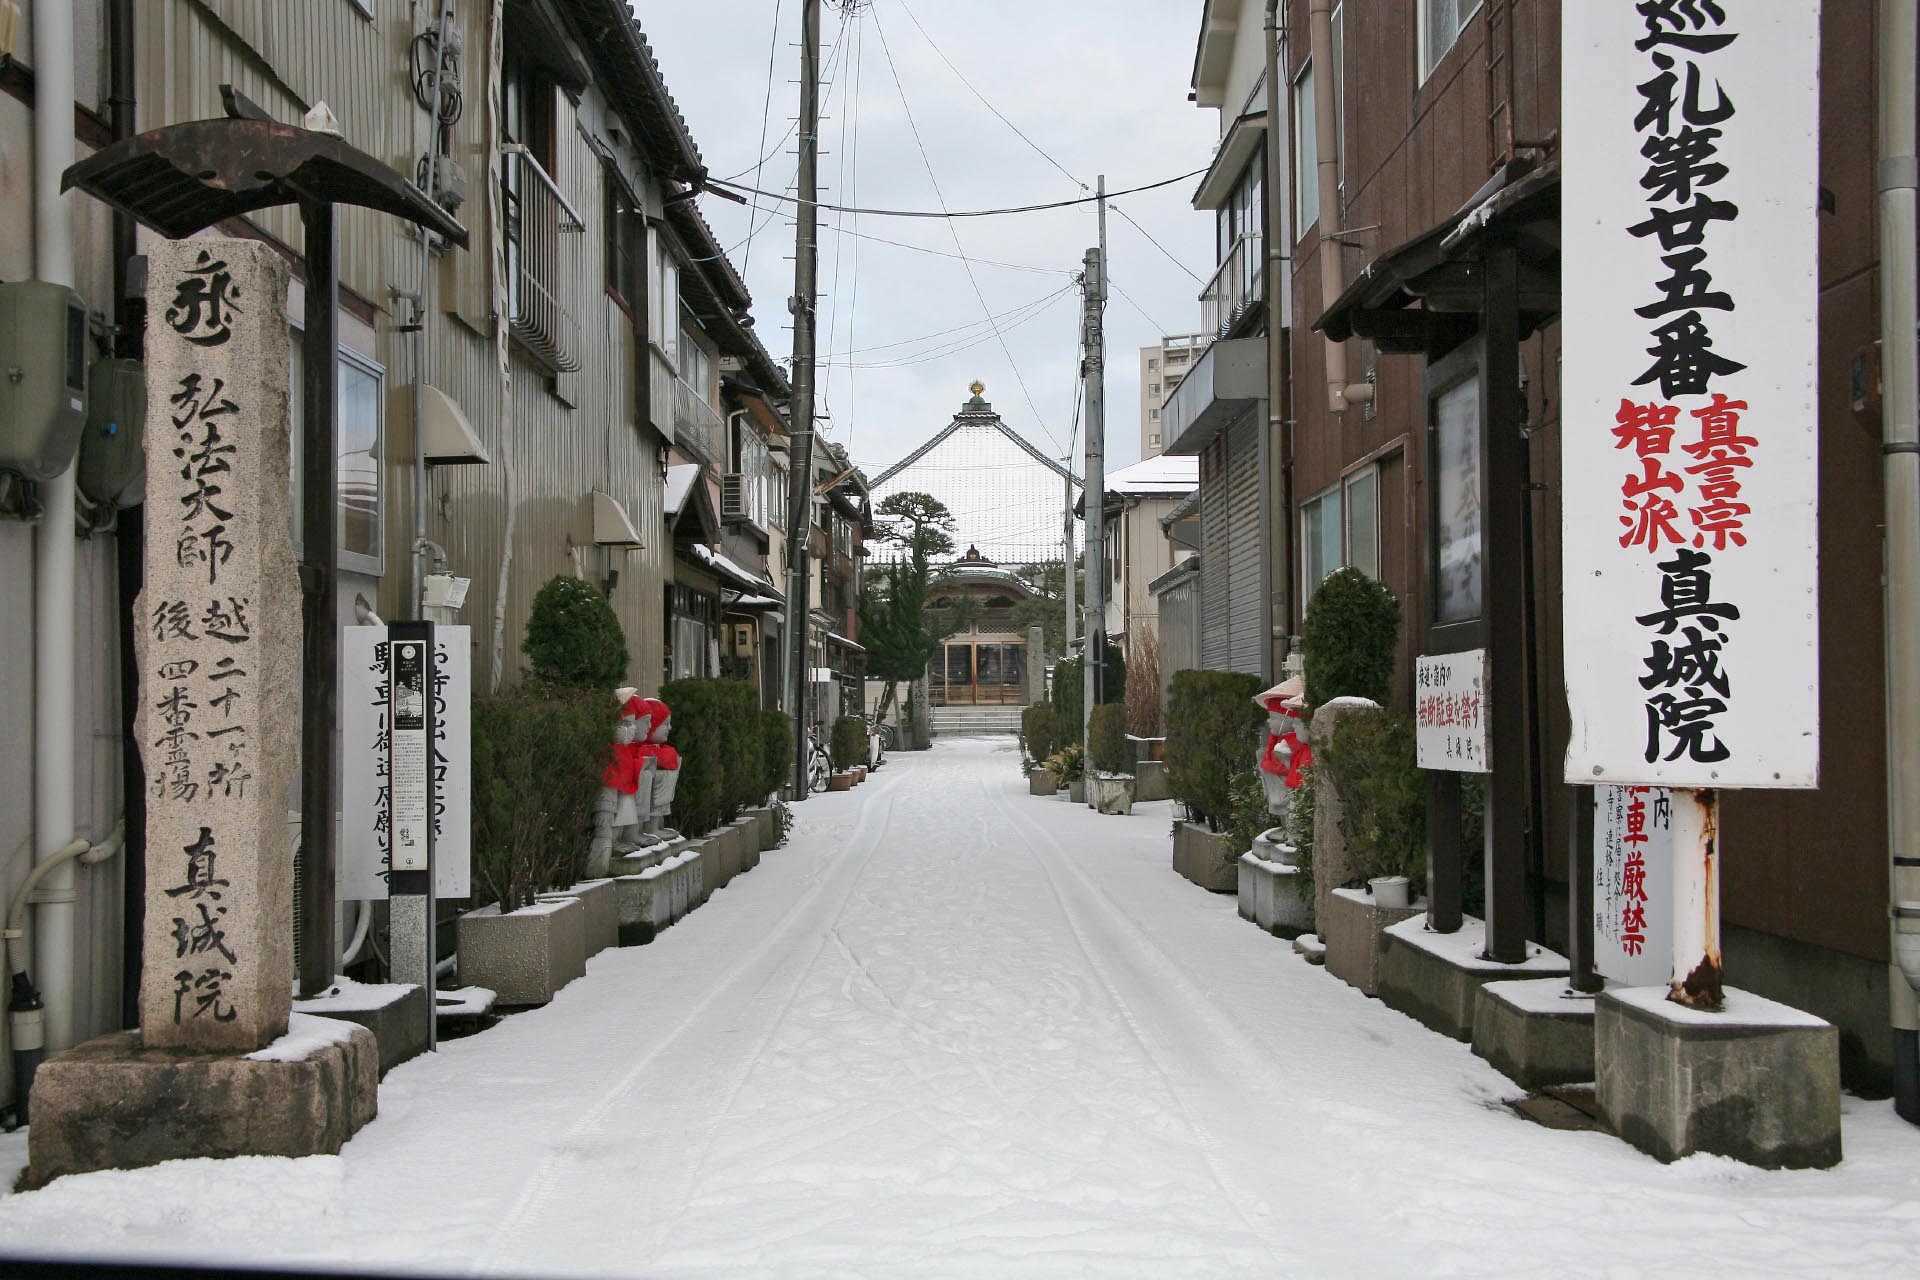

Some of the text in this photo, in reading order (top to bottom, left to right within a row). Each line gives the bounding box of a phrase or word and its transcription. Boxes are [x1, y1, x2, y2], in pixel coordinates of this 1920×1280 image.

[171, 374, 239, 585] 弘法大師
[1611, 398, 1686, 553] 智山派
[1681, 394, 1759, 550] 真言宗
[1418, 690, 1481, 730] 無断駐車を禁ず
[1635, 547, 1740, 763] 真城院
[1446, 735, 1473, 760] 真城院
[164, 827, 238, 1025] 真城院
